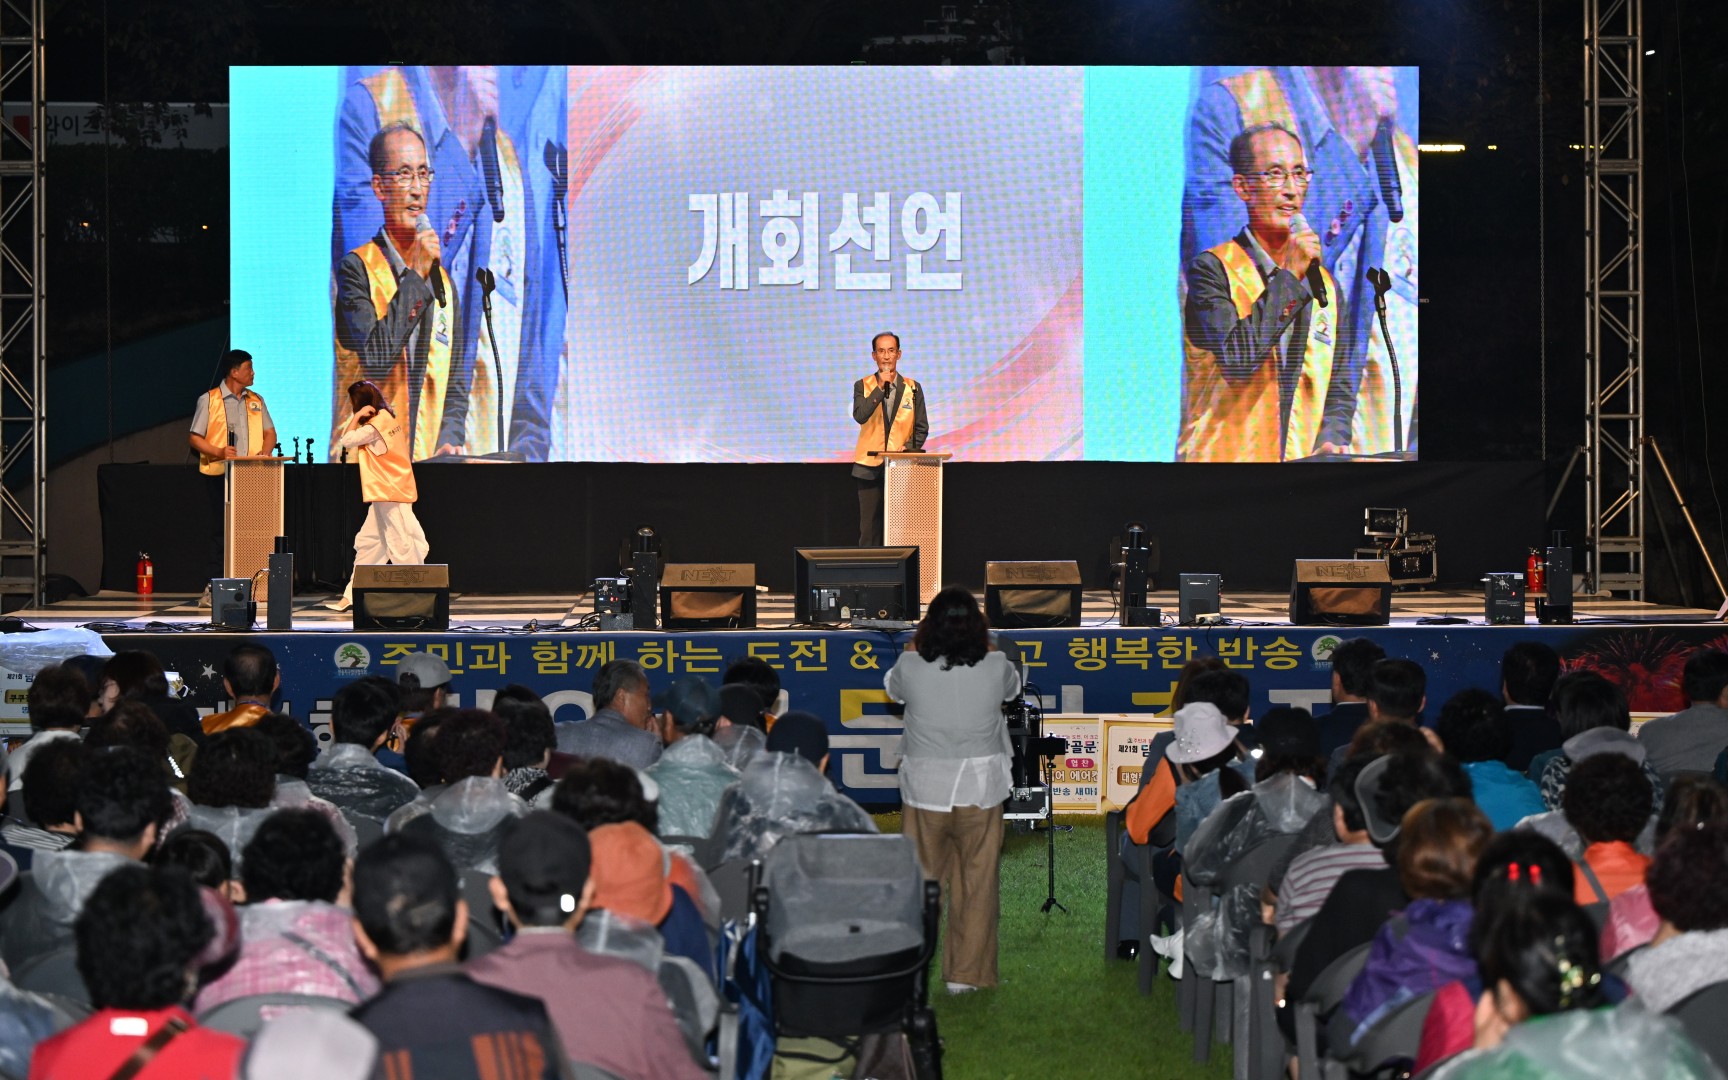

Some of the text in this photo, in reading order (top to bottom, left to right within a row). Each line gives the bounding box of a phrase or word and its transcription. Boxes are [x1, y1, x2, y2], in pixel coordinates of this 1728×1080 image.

[688, 189, 964, 291] 개회선언
[531, 641, 615, 675] 함께
[637, 640, 723, 673] 하는
[850, 641, 880, 670] &
[1067, 636, 1198, 671] 행복한
[1218, 635, 1303, 671] 반송
[1118, 744, 1138, 754] 제21회
